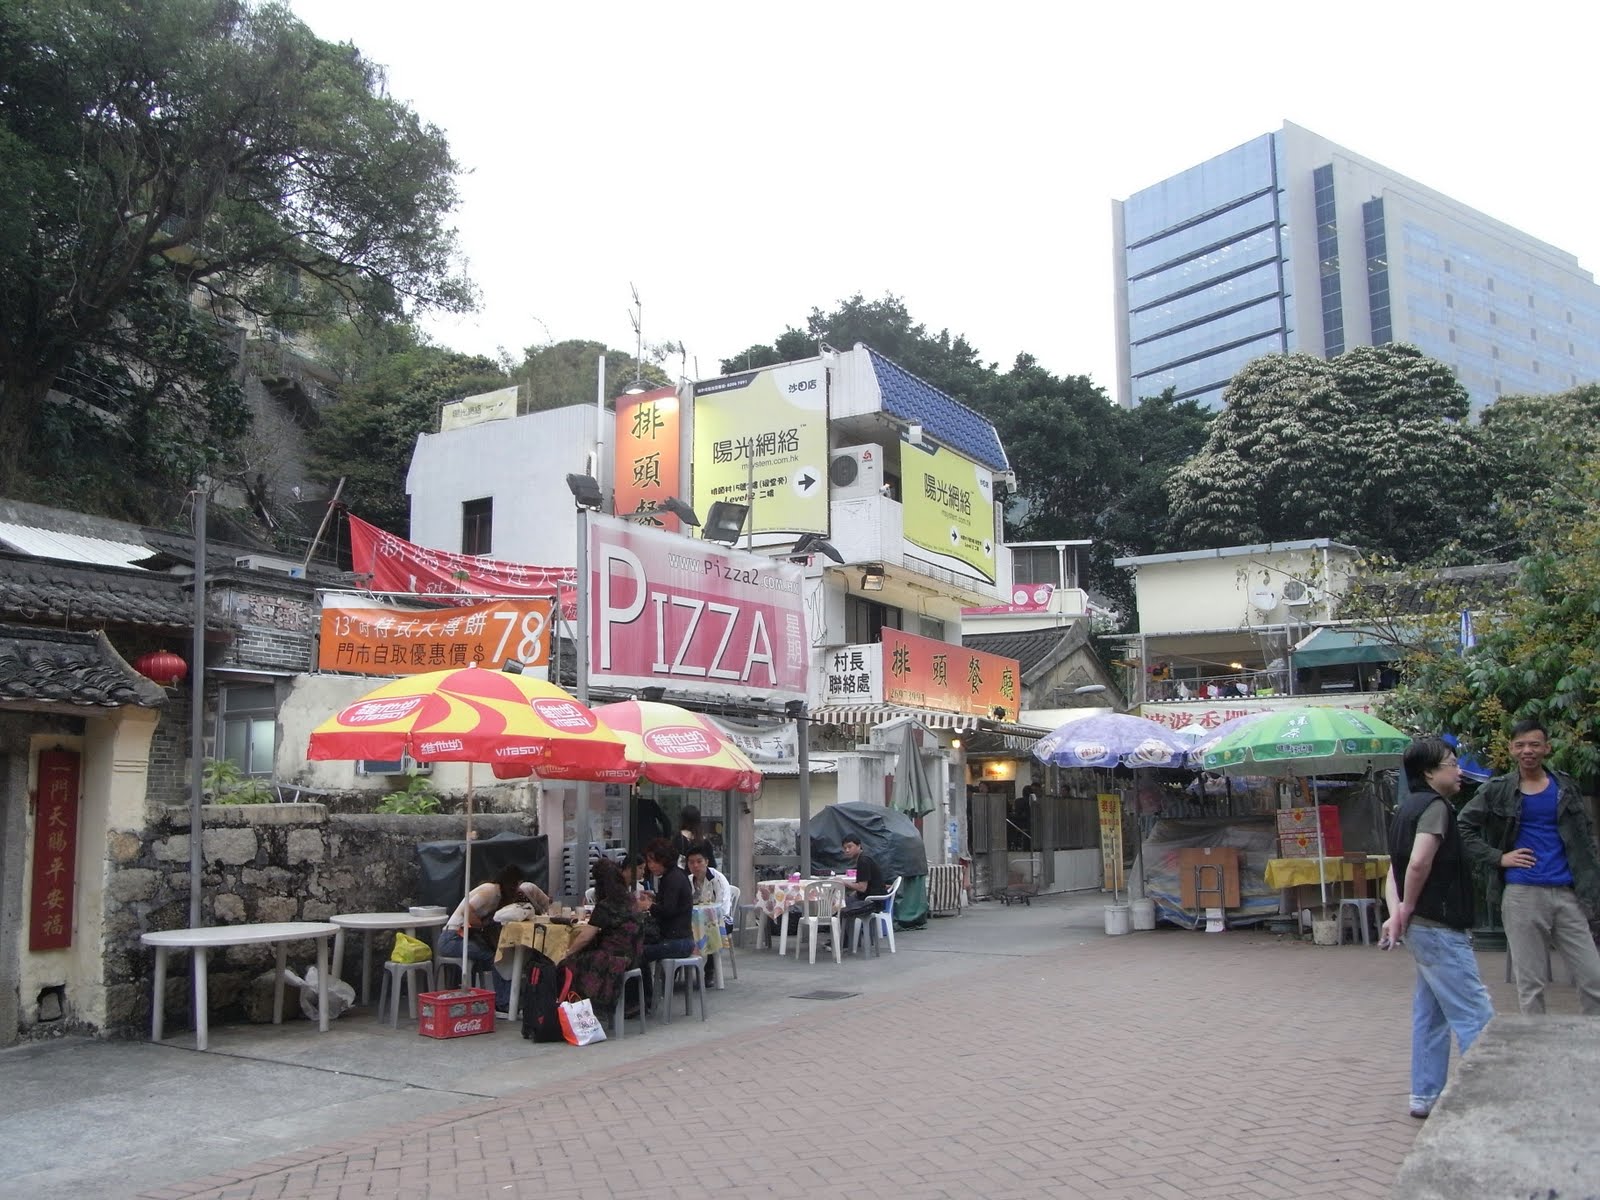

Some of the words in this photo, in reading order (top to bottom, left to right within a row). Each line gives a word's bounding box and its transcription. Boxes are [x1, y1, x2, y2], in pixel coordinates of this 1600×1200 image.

[713, 428, 800, 465] 陽光網絡
[924, 472, 972, 516] 陽光網絡
[599, 542, 777, 686] PIZZA
[491, 611, 545, 665] 78
[829, 673, 870, 695] 聯絡處
[834, 651, 864, 673] 村長
[891, 641, 1014, 702] 排頭餐廳
[420, 739, 463, 755] 維他奶
[43, 765, 72, 937] 一門天賜平安福
